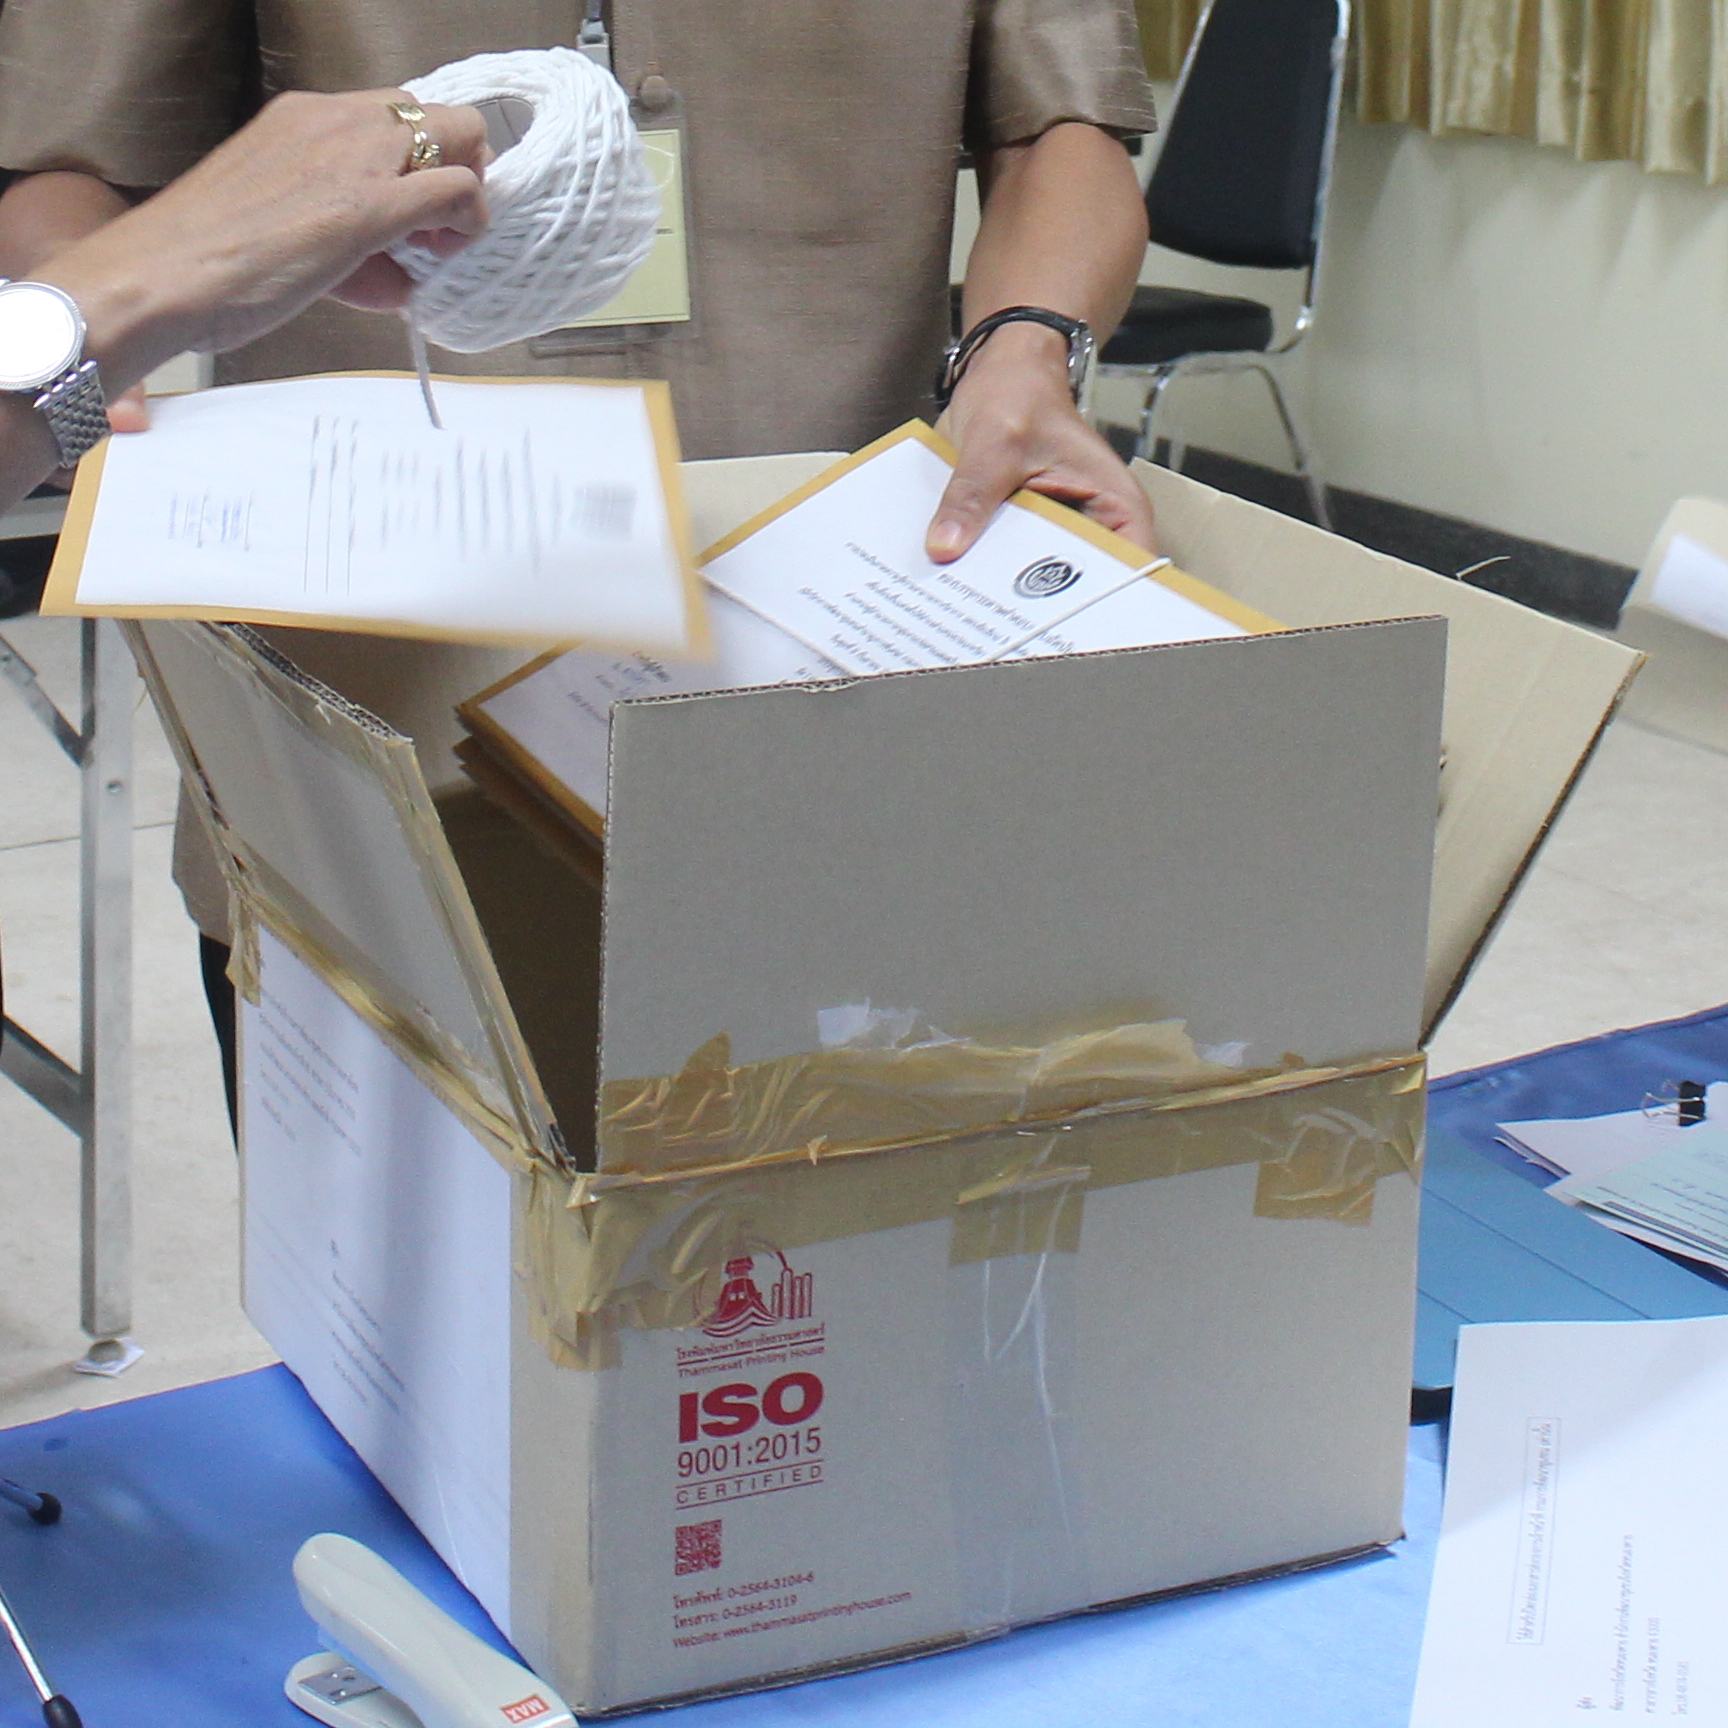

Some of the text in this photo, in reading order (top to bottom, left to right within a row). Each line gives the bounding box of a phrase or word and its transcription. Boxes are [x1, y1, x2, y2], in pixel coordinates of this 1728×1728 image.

[679, 1346, 825, 1377] Thammasat Printing House
[679, 1372, 824, 1443] ISO
[678, 1427, 821, 1477] 9001:2015
[677, 1465, 822, 1504] CERTIFIED
[727, 1571, 814, 1598] 0-2564-3104-6
[723, 1594, 798, 1620] 0-2564-3119
[504, 1698, 545, 1722] MAX
